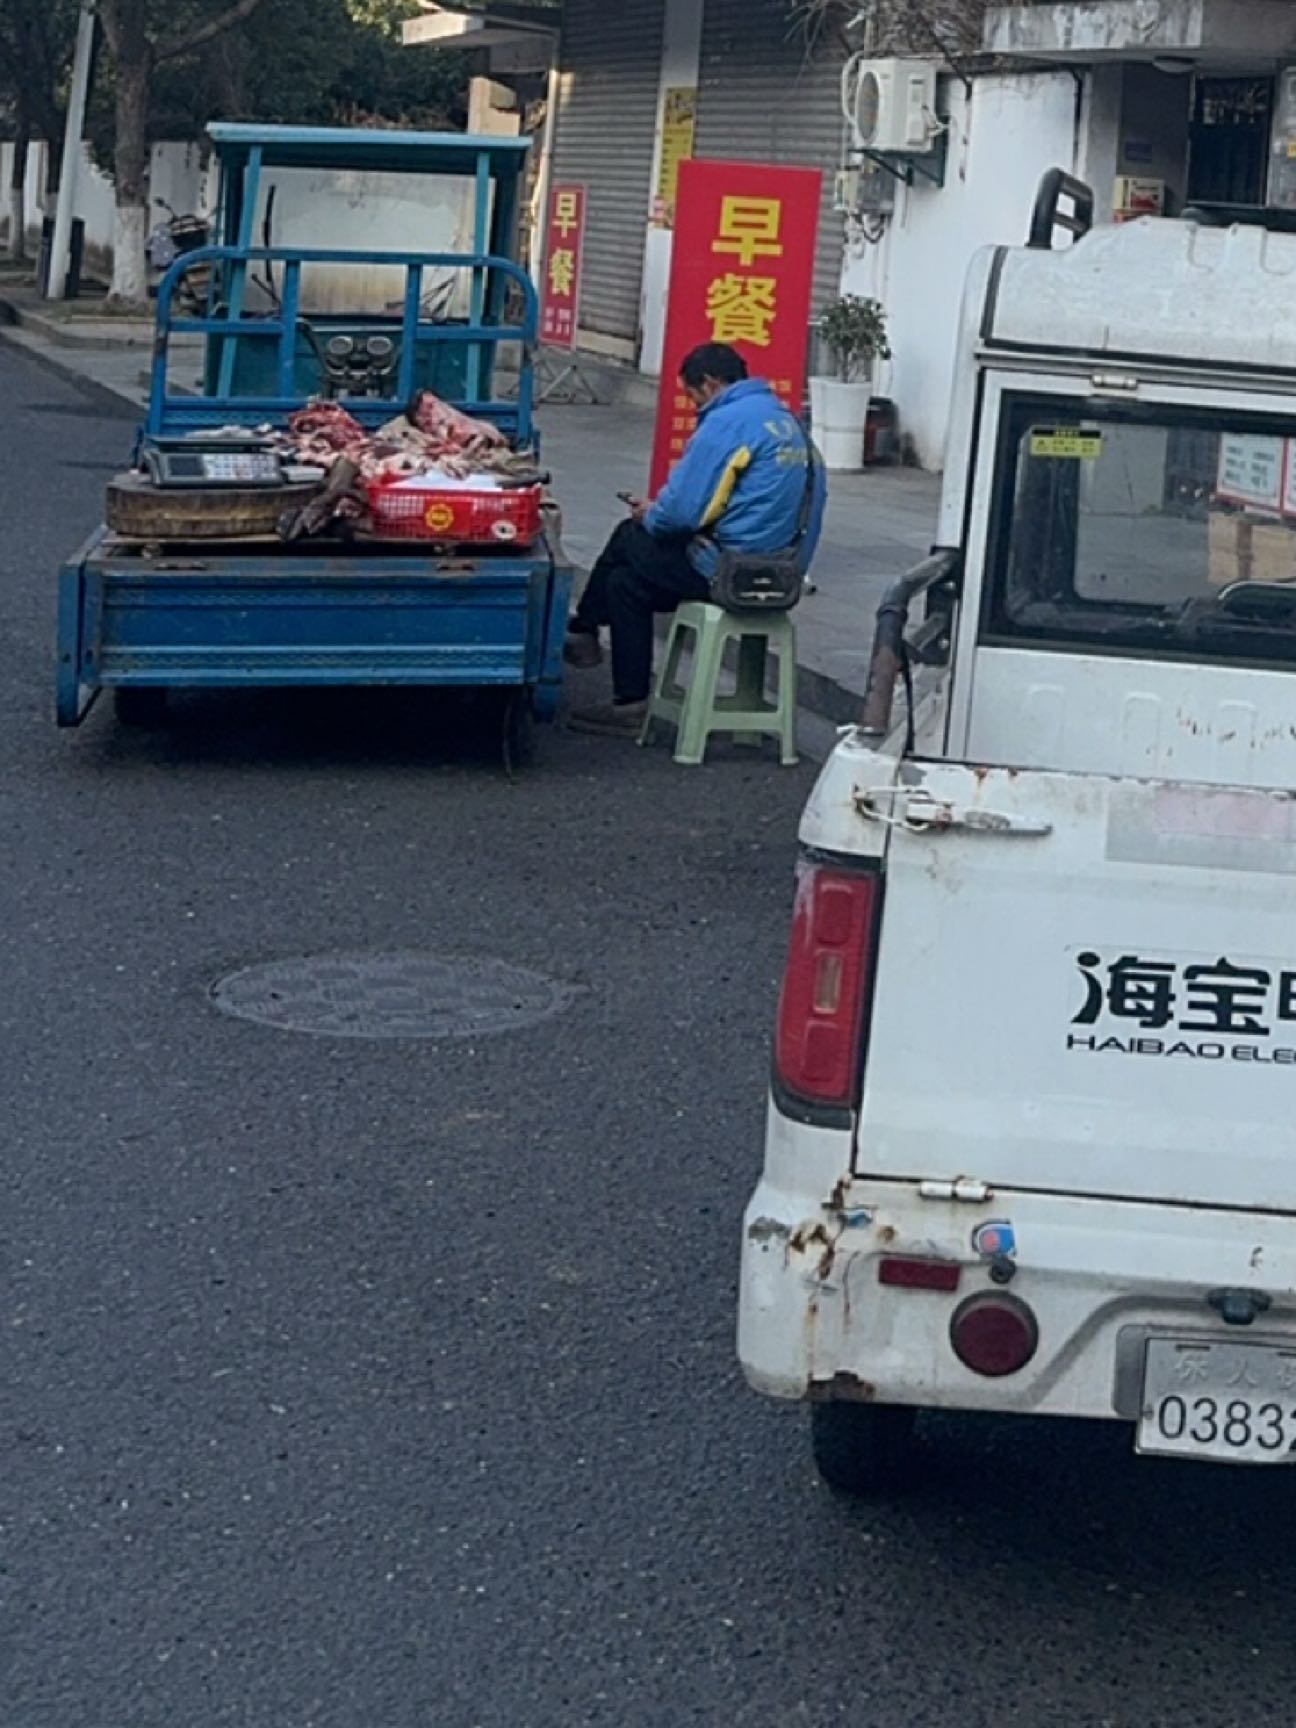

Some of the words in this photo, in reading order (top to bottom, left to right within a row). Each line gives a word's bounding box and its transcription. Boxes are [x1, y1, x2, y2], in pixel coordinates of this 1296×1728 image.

[549, 192, 577, 297] 早餐
[705, 194, 784, 348] 早餐
[1066, 1034, 1225, 1060] HAIBAO
